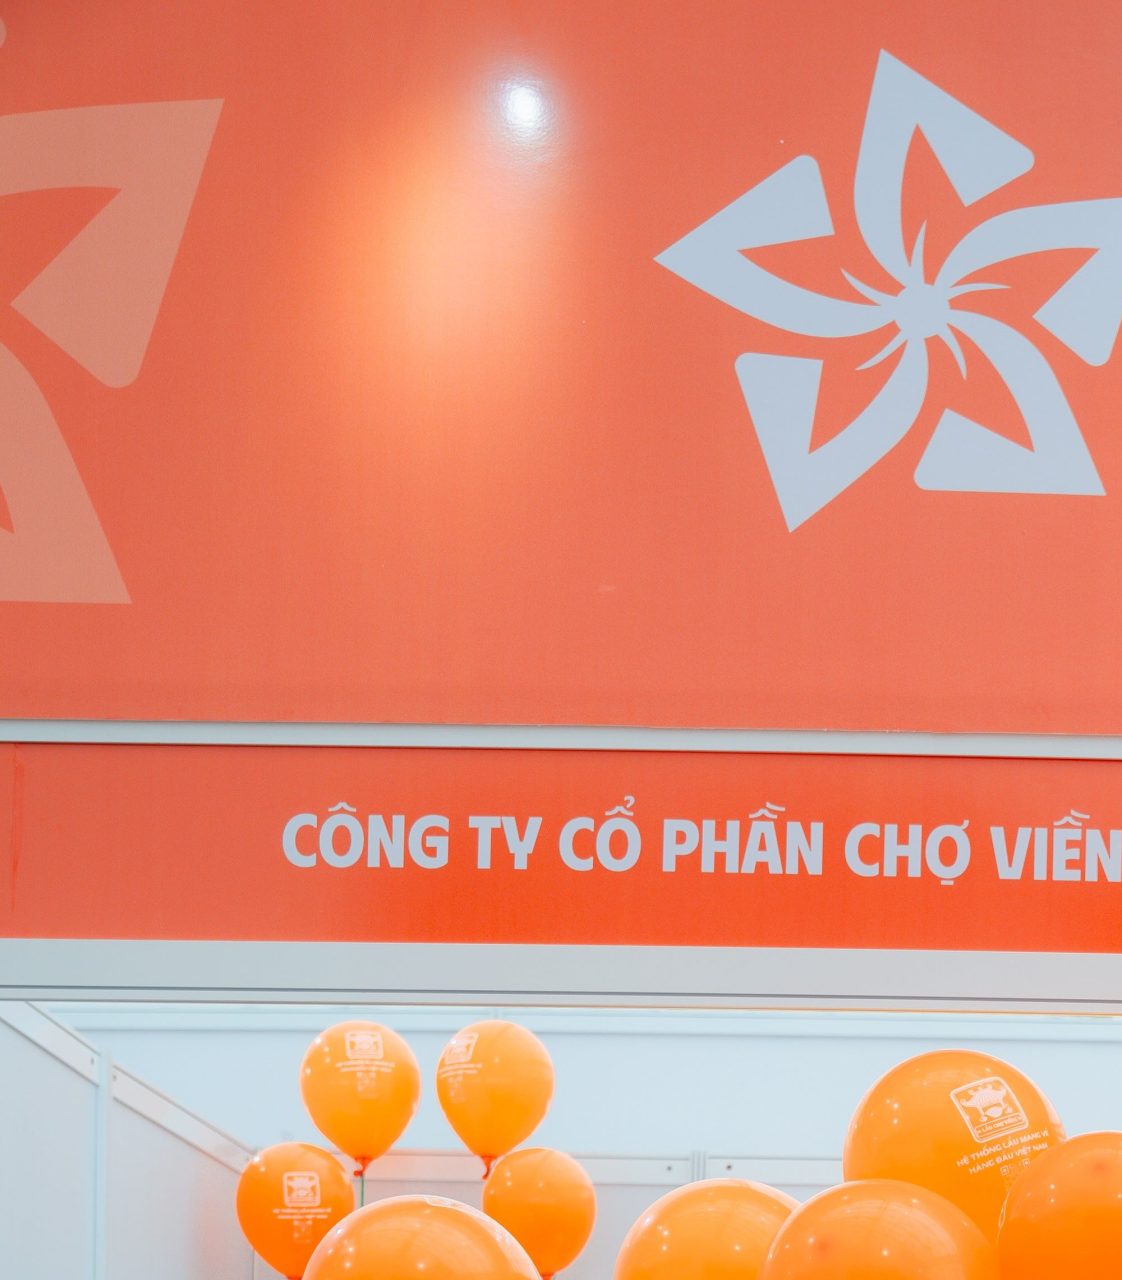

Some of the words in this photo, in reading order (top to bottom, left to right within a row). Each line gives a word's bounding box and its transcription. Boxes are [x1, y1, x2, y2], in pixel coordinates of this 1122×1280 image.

[282, 801, 450, 868] CÔNG
[468, 816, 543, 870] TY
[559, 795, 642, 872] CỔ
[662, 802, 823, 875] PHẦN
[844, 820, 971, 886] CHỢ
